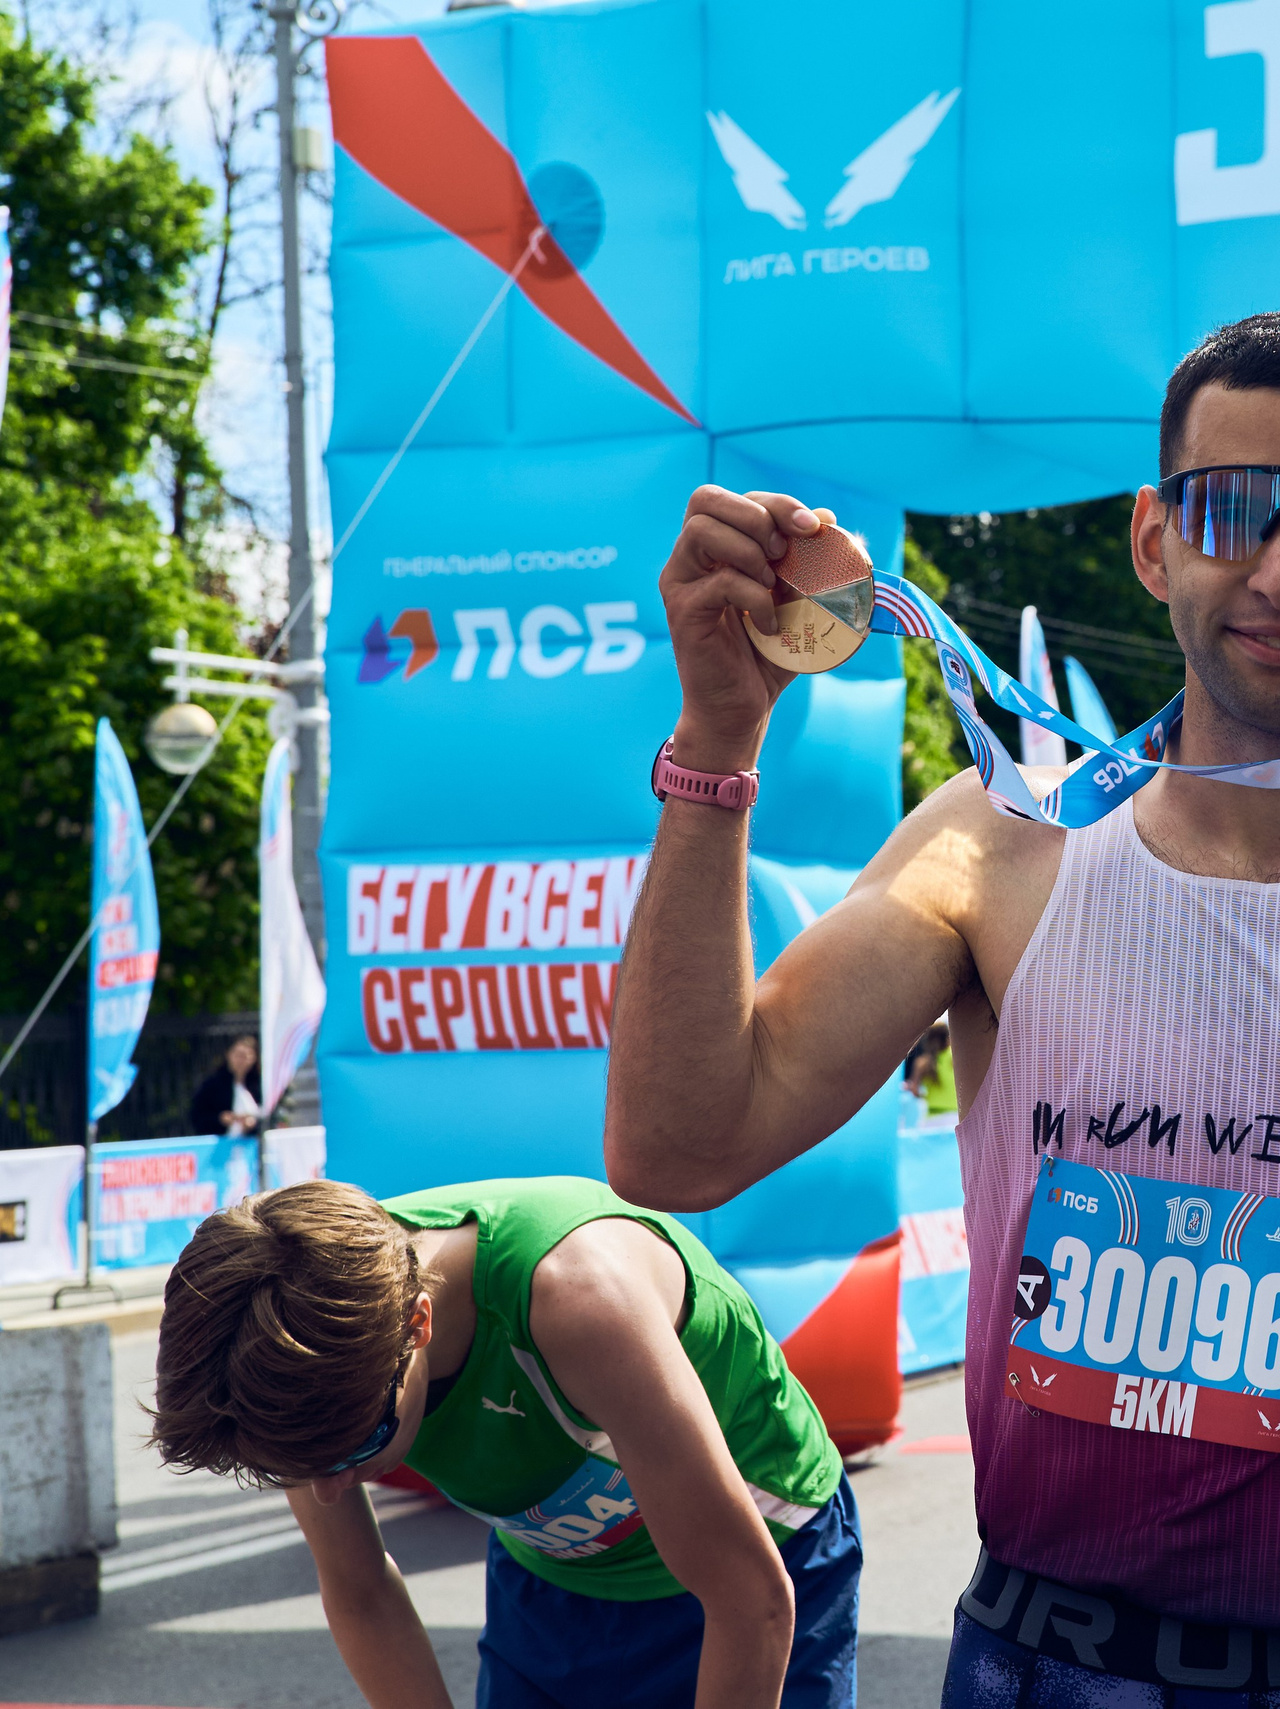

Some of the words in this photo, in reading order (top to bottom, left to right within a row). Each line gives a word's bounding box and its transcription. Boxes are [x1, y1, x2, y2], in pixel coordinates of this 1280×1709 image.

[723, 252, 796, 285] ЛИГА
[803, 246, 930, 275] ГЕРОЕВ
[514, 545, 618, 573] СПОНСОР
[451, 601, 646, 681] ПСБ
[348, 864, 487, 955] БЕГУ
[1063, 1192, 1099, 1214] ПСБ
[1165, 1196, 1212, 1246] 10
